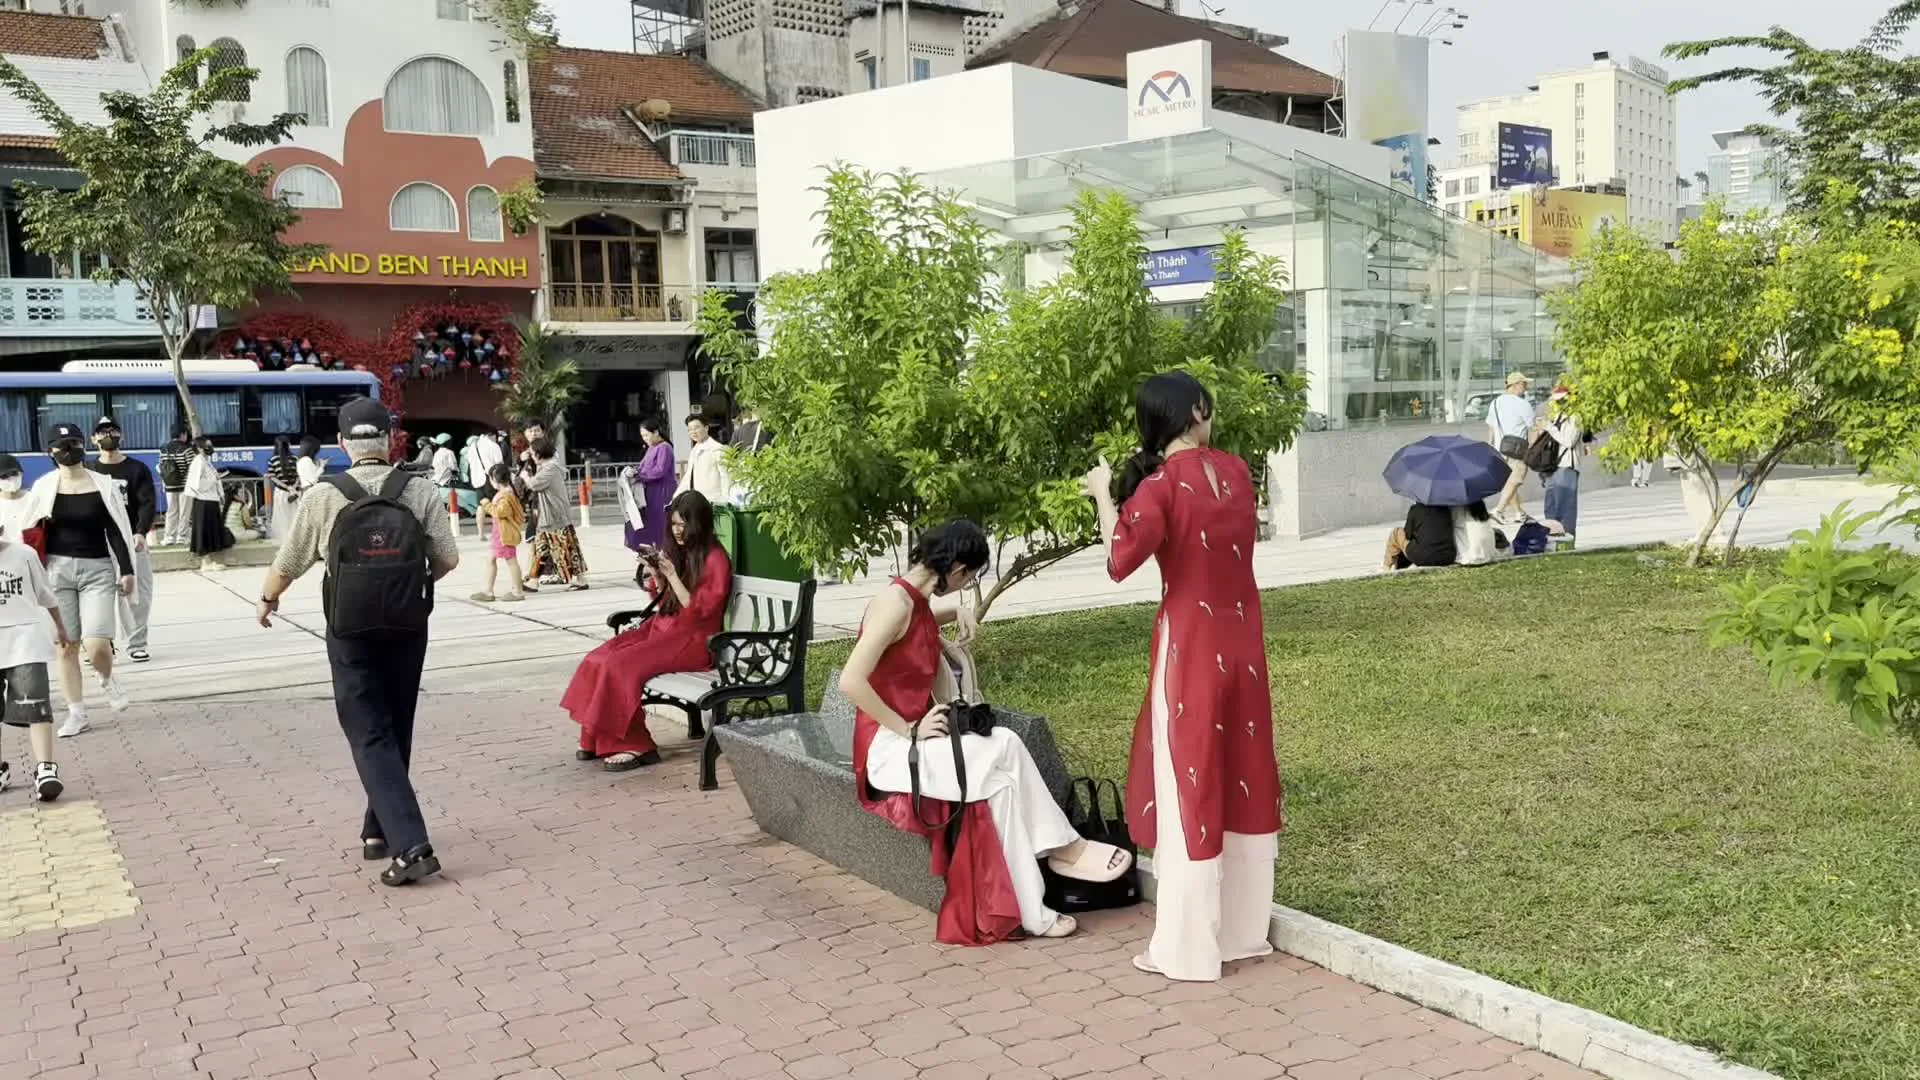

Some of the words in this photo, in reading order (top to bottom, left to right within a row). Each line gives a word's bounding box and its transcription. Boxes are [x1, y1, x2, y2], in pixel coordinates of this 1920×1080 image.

[1164, 100, 1196, 113] METRO
[1541, 212, 1584, 229] MUFASA
[378, 254, 428, 276] BEN
[437, 255, 527, 278] THANH
